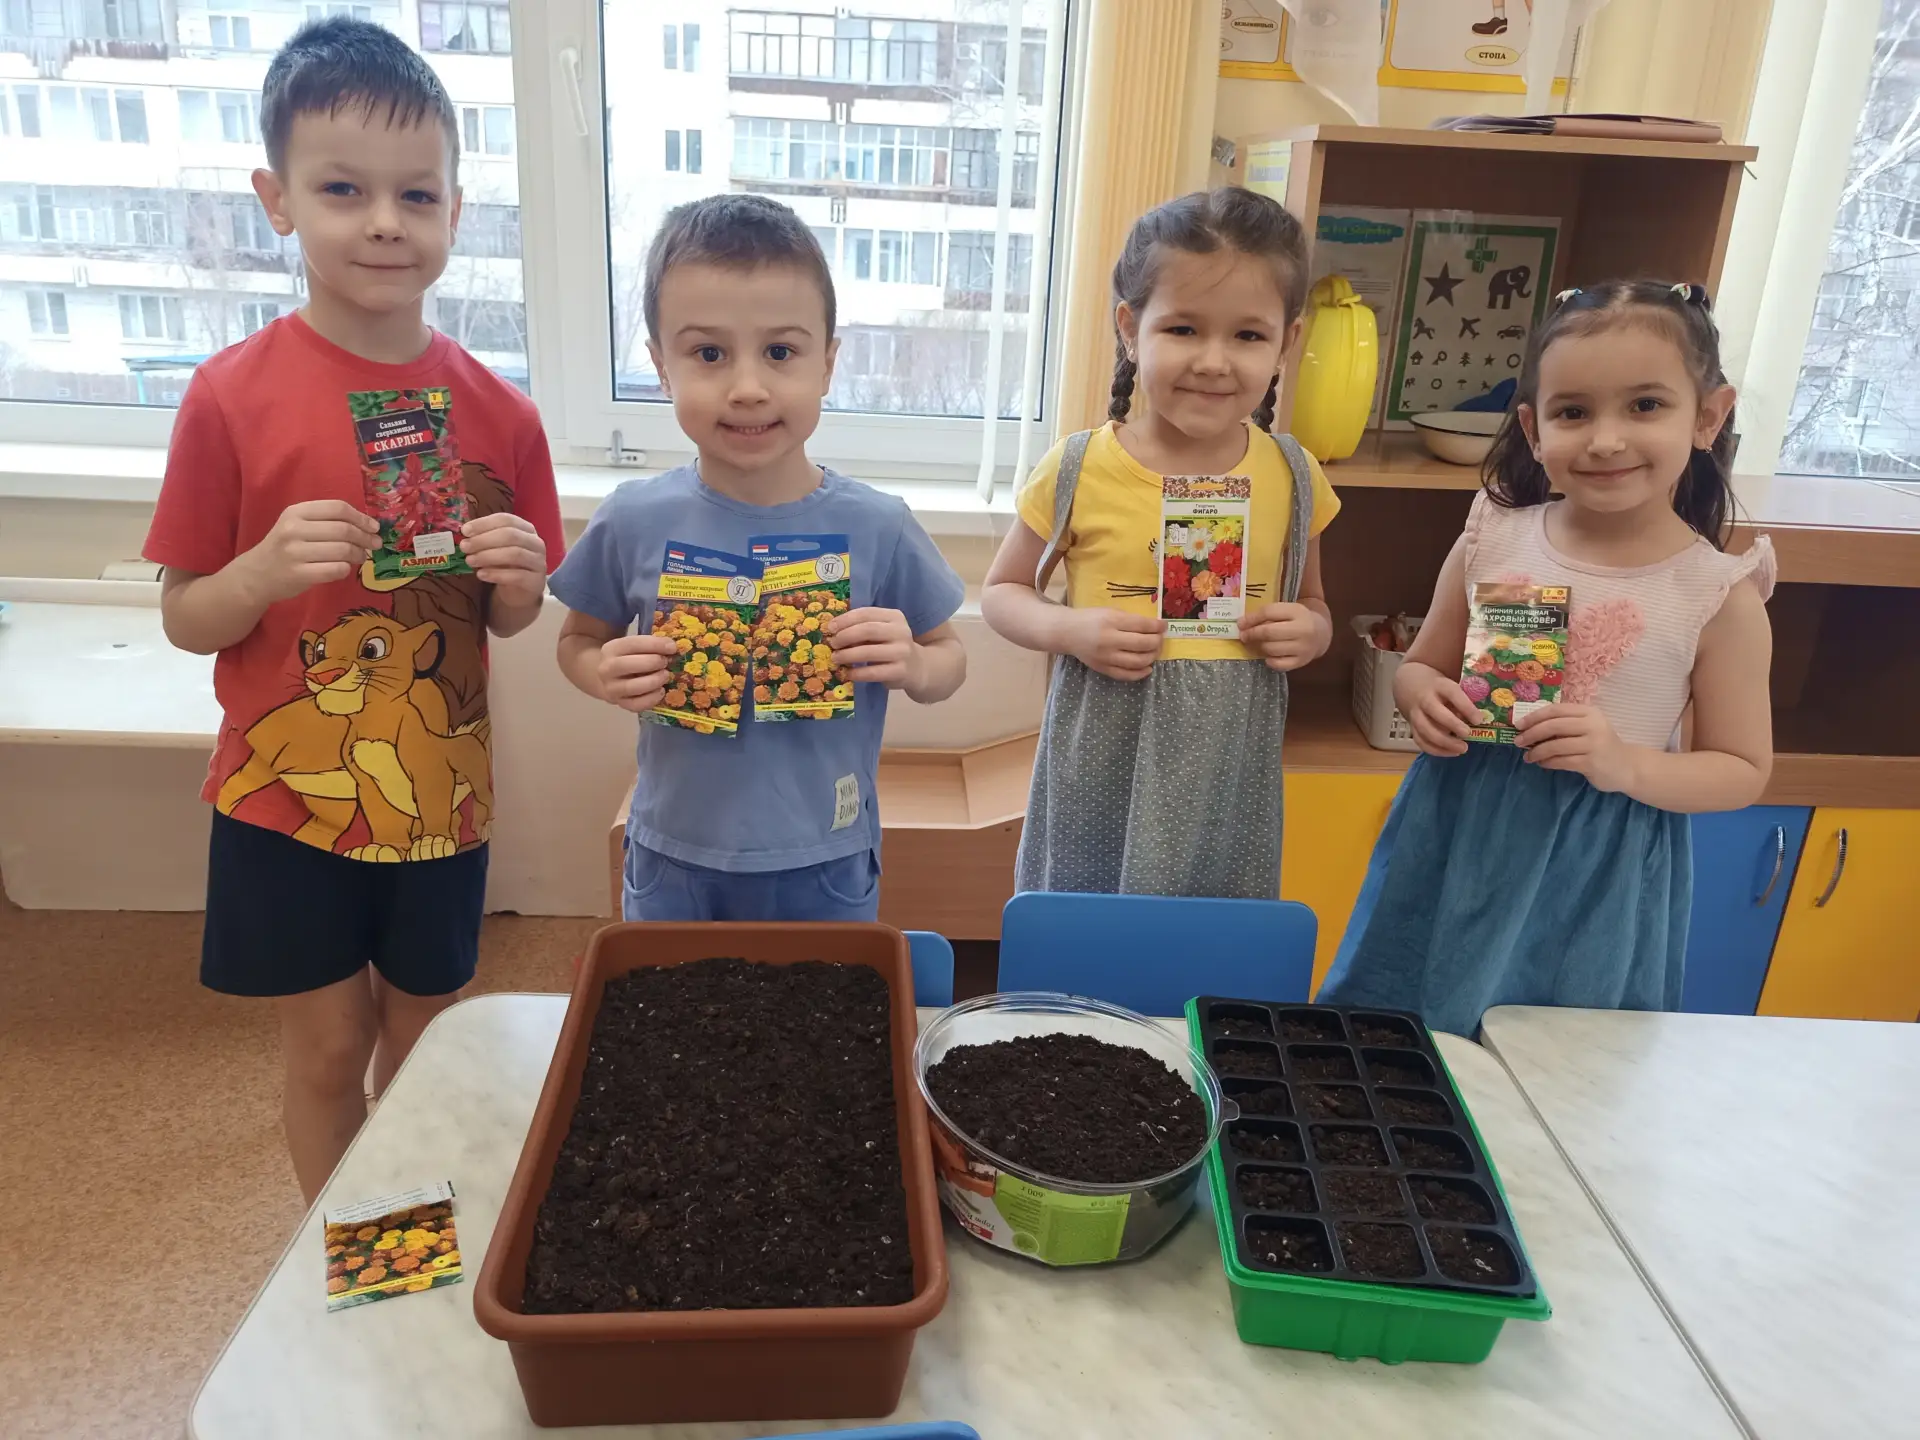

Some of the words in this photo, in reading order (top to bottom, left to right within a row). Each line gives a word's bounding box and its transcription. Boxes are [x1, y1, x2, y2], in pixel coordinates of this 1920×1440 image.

[1478, 51, 1506, 60] СТОПА
[374, 433, 424, 452] СКАРЛЕТ
[401, 555, 447, 567] АЭЛИТА
[666, 566, 684, 574] ЛИНИЯ
[667, 561, 703, 573] ГОЛЛАНДСКАЯ
[1485, 606, 1513, 614] ЦИННИЯ
[1169, 624, 1196, 634] Русский
[1206, 625, 1230, 634] Огород
[1469, 729, 1494, 738] ЛИТА
